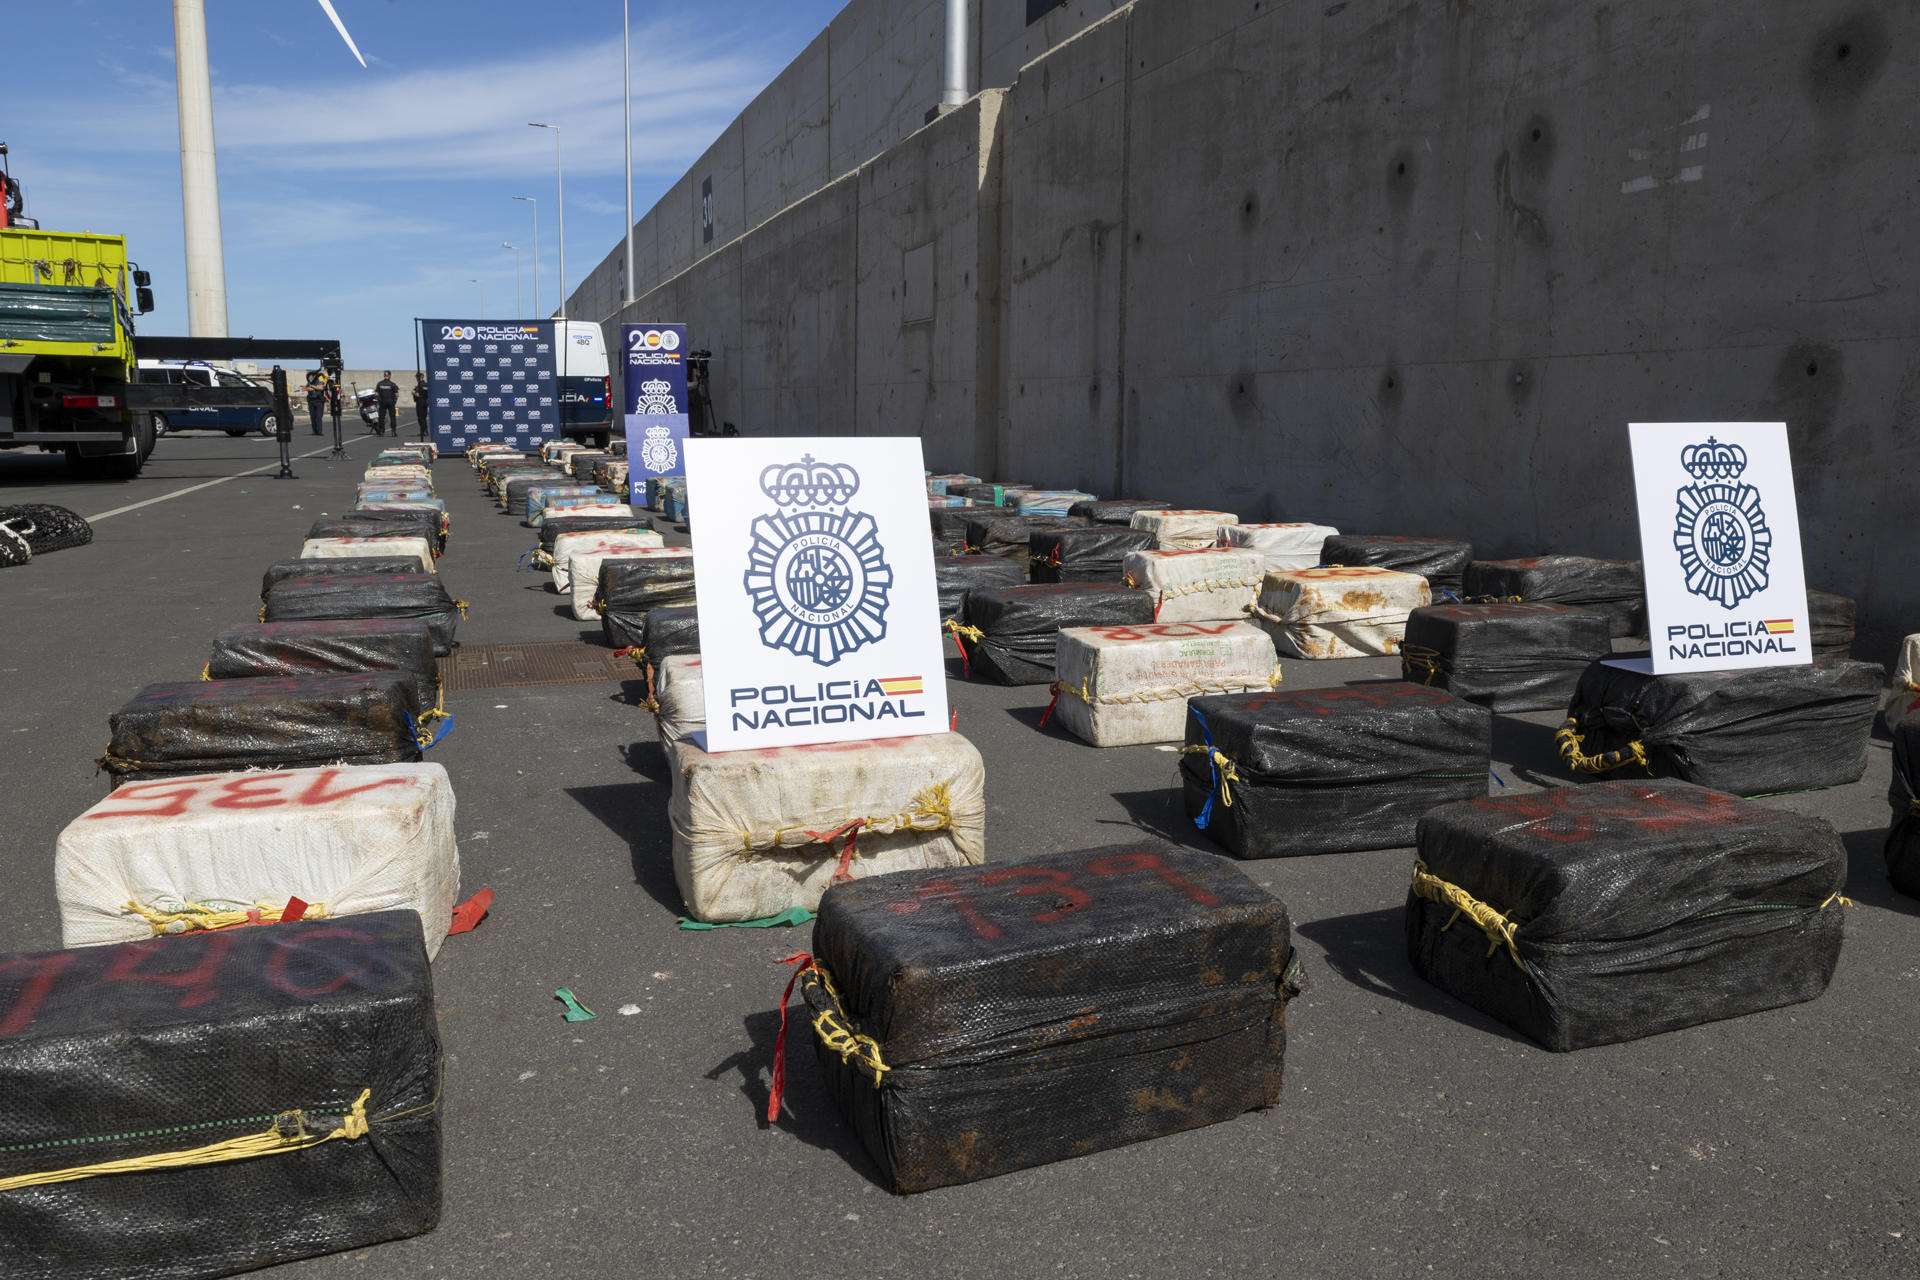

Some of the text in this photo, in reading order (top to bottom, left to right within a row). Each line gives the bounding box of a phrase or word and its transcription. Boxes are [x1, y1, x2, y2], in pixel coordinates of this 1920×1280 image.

[477, 333, 539, 341] NACIONAL
[629, 330, 680, 350] 200
[1705, 558, 1748, 575] NACIONAL
[790, 602, 854, 622] NACIONAL
[1669, 637, 1796, 660] NACIONAL
[732, 699, 926, 732] NACIONAL
